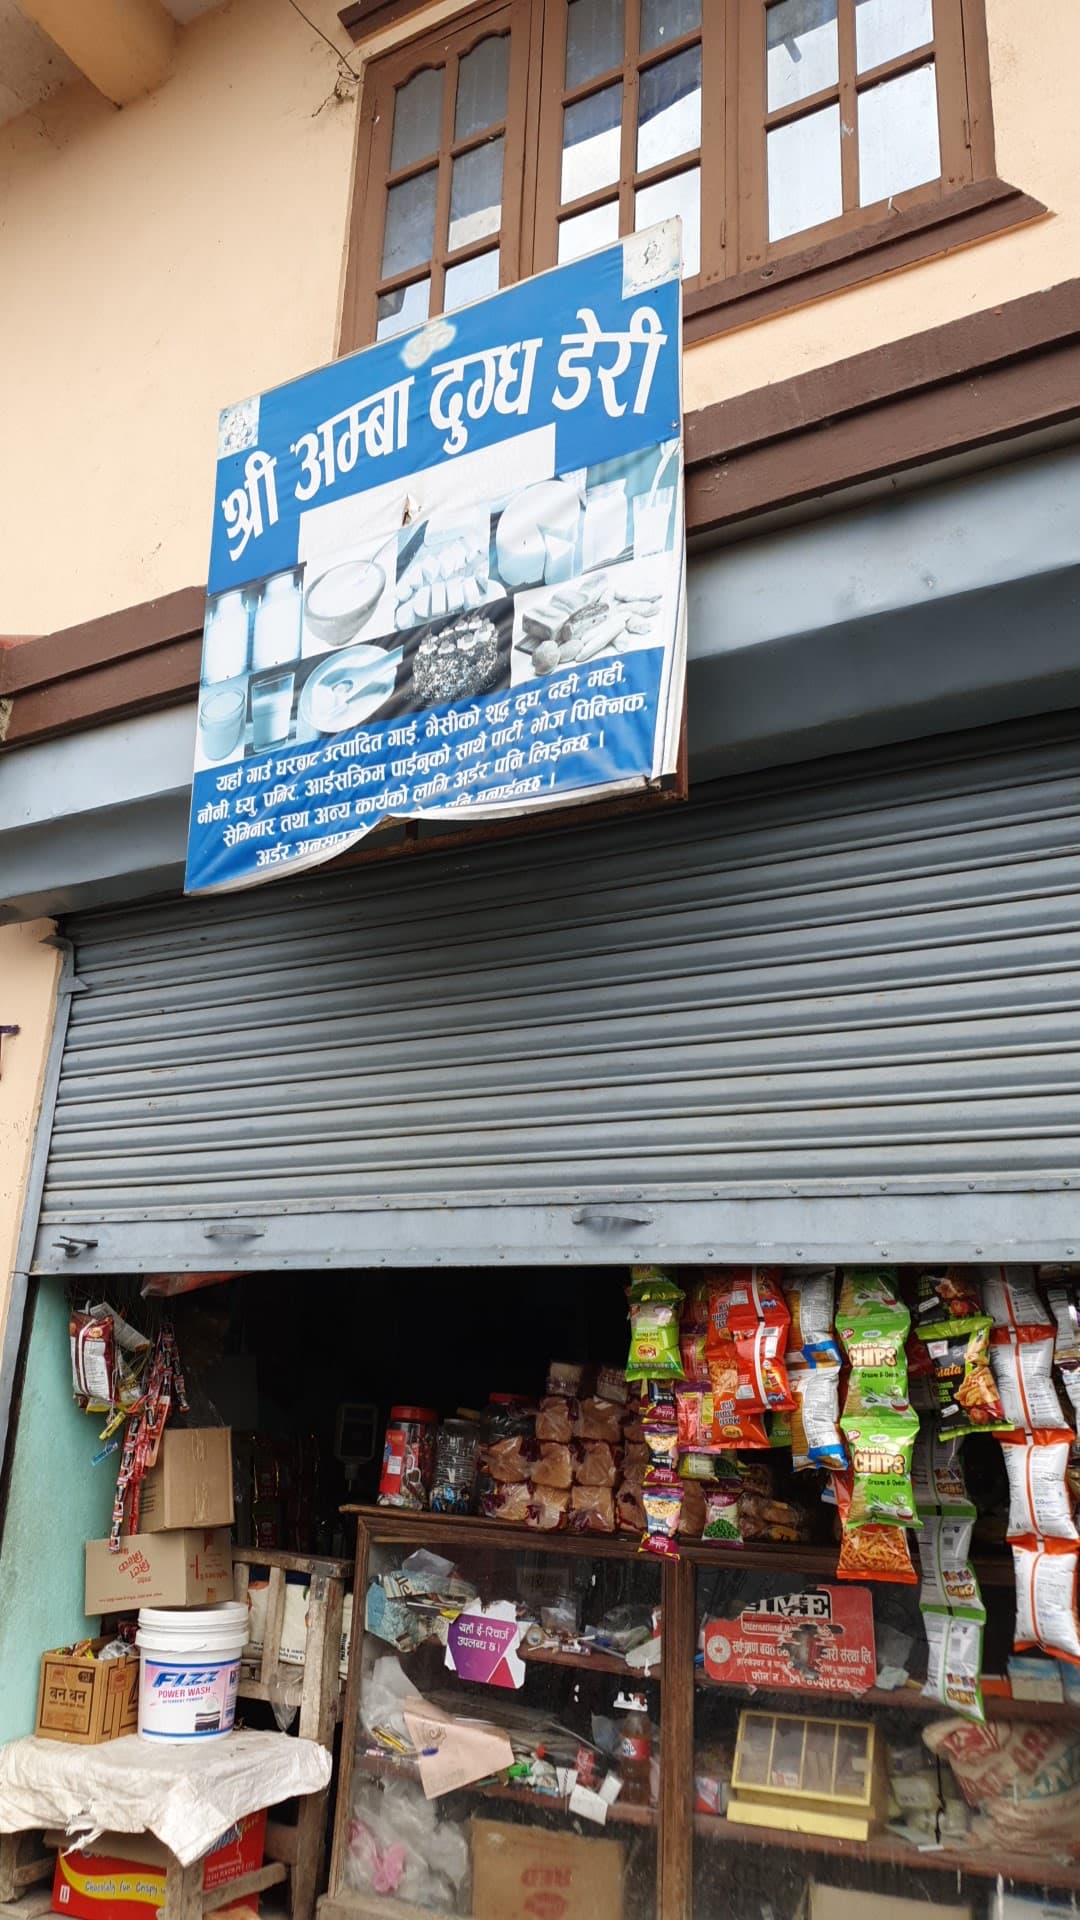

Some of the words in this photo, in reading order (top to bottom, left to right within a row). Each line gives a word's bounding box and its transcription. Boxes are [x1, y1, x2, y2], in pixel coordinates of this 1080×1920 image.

[222, 450, 279, 562] श्री
[289, 375, 415, 502] अम्बा
[429, 337, 543, 456] दुग्ध
[551, 306, 668, 418] डेरी
[216, 766, 243, 792] यहाँ
[246, 758, 273, 784] गाउँ
[276, 751, 321, 776] घरबाट
[323, 731, 383, 763] उत्पादित
[304, 764, 386, 797] आईसक्रिम
[391, 743, 451, 776] पाईनुको
[455, 731, 487, 761] साथै
[530, 709, 568, 735] भोज
[222, 818, 277, 848] सेमिनार
[281, 811, 310, 833] तथा
[314, 801, 351, 825] अन्य
[355, 784, 409, 815] कार्यको
[412, 773, 450, 803] लागि
[453, 758, 492, 788] अर्डर
[494, 747, 525, 772] पनि
[848, 1346, 898, 1368] CHIPS
[854, 1453, 906, 1475] CHIPS
[458, 1622, 475, 1634] यहाँ
[457, 1636, 487, 1651] उपलब्ध
[152, 1670, 221, 1688] FIZZ
[158, 1688, 186, 1699] POWER
[187, 1686, 212, 1697] WASH
